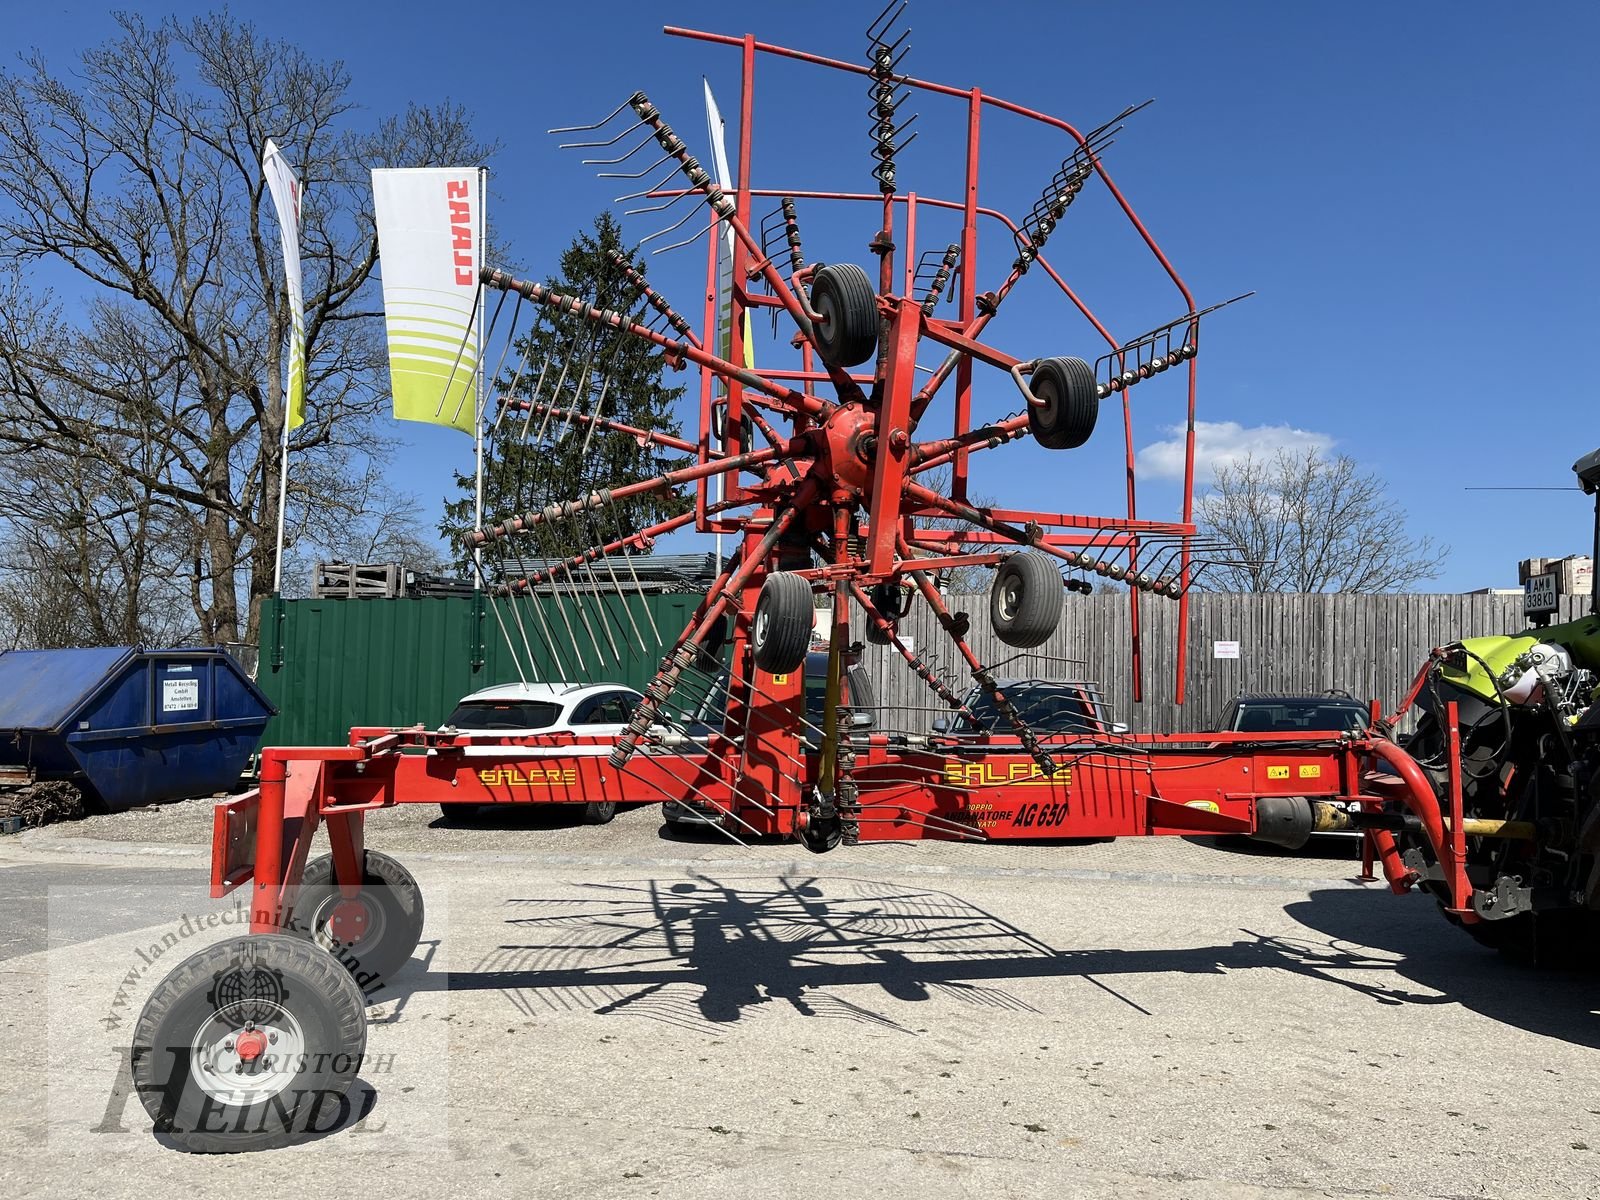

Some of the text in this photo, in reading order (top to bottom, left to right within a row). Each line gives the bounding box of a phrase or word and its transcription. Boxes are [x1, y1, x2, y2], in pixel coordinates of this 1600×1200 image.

[1534, 578, 1544, 592] AM
[1012, 803, 1069, 827] AG 650
